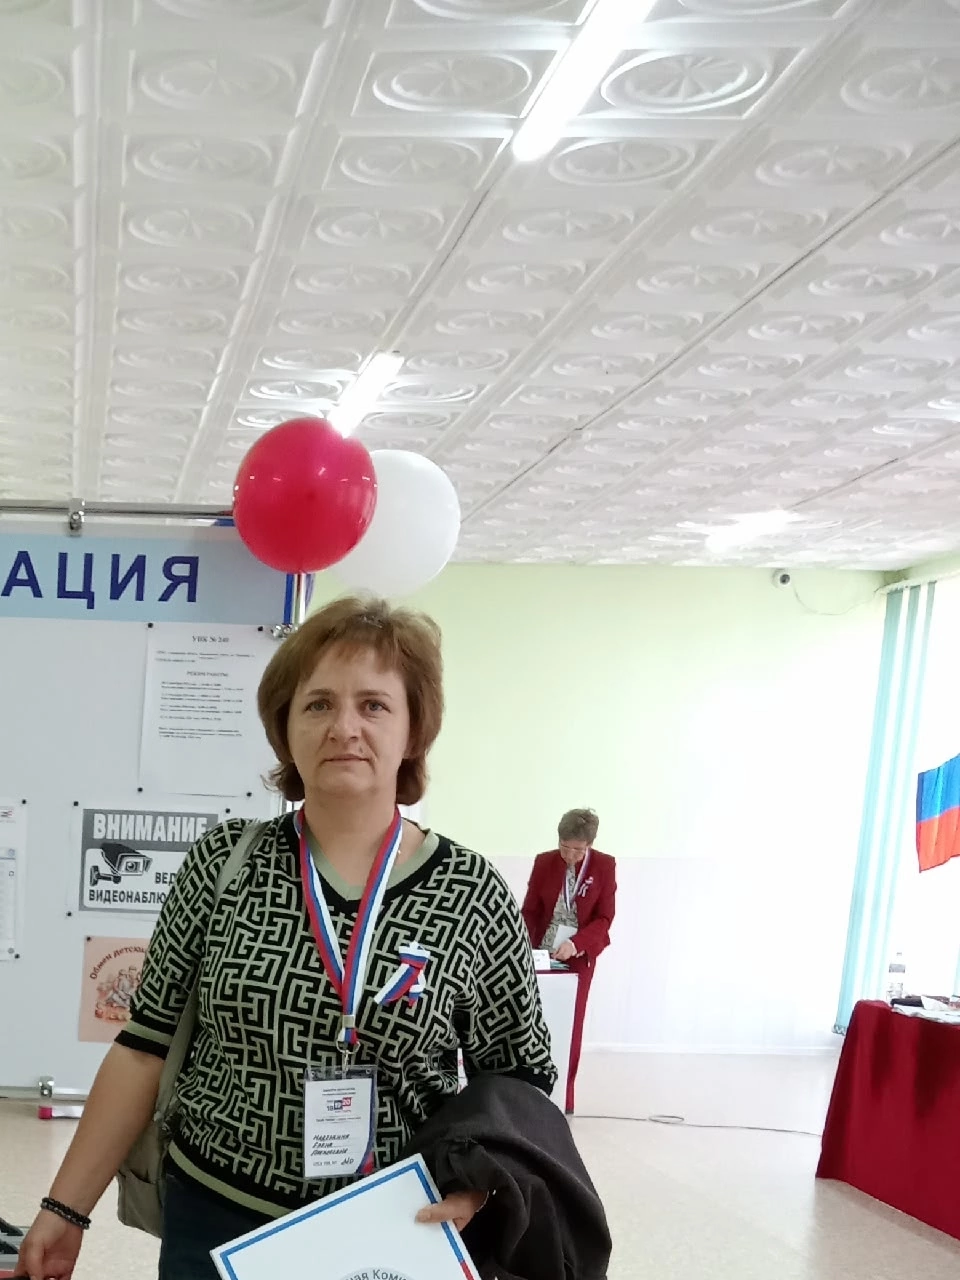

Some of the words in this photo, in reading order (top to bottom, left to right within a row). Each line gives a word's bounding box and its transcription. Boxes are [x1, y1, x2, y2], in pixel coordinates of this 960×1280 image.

[93, 813, 208, 842] ВНИМАНИЕ
[155, 872, 176, 886] ВЕД
[89, 889, 167, 904] ВИДЕОНАБЛЮ
